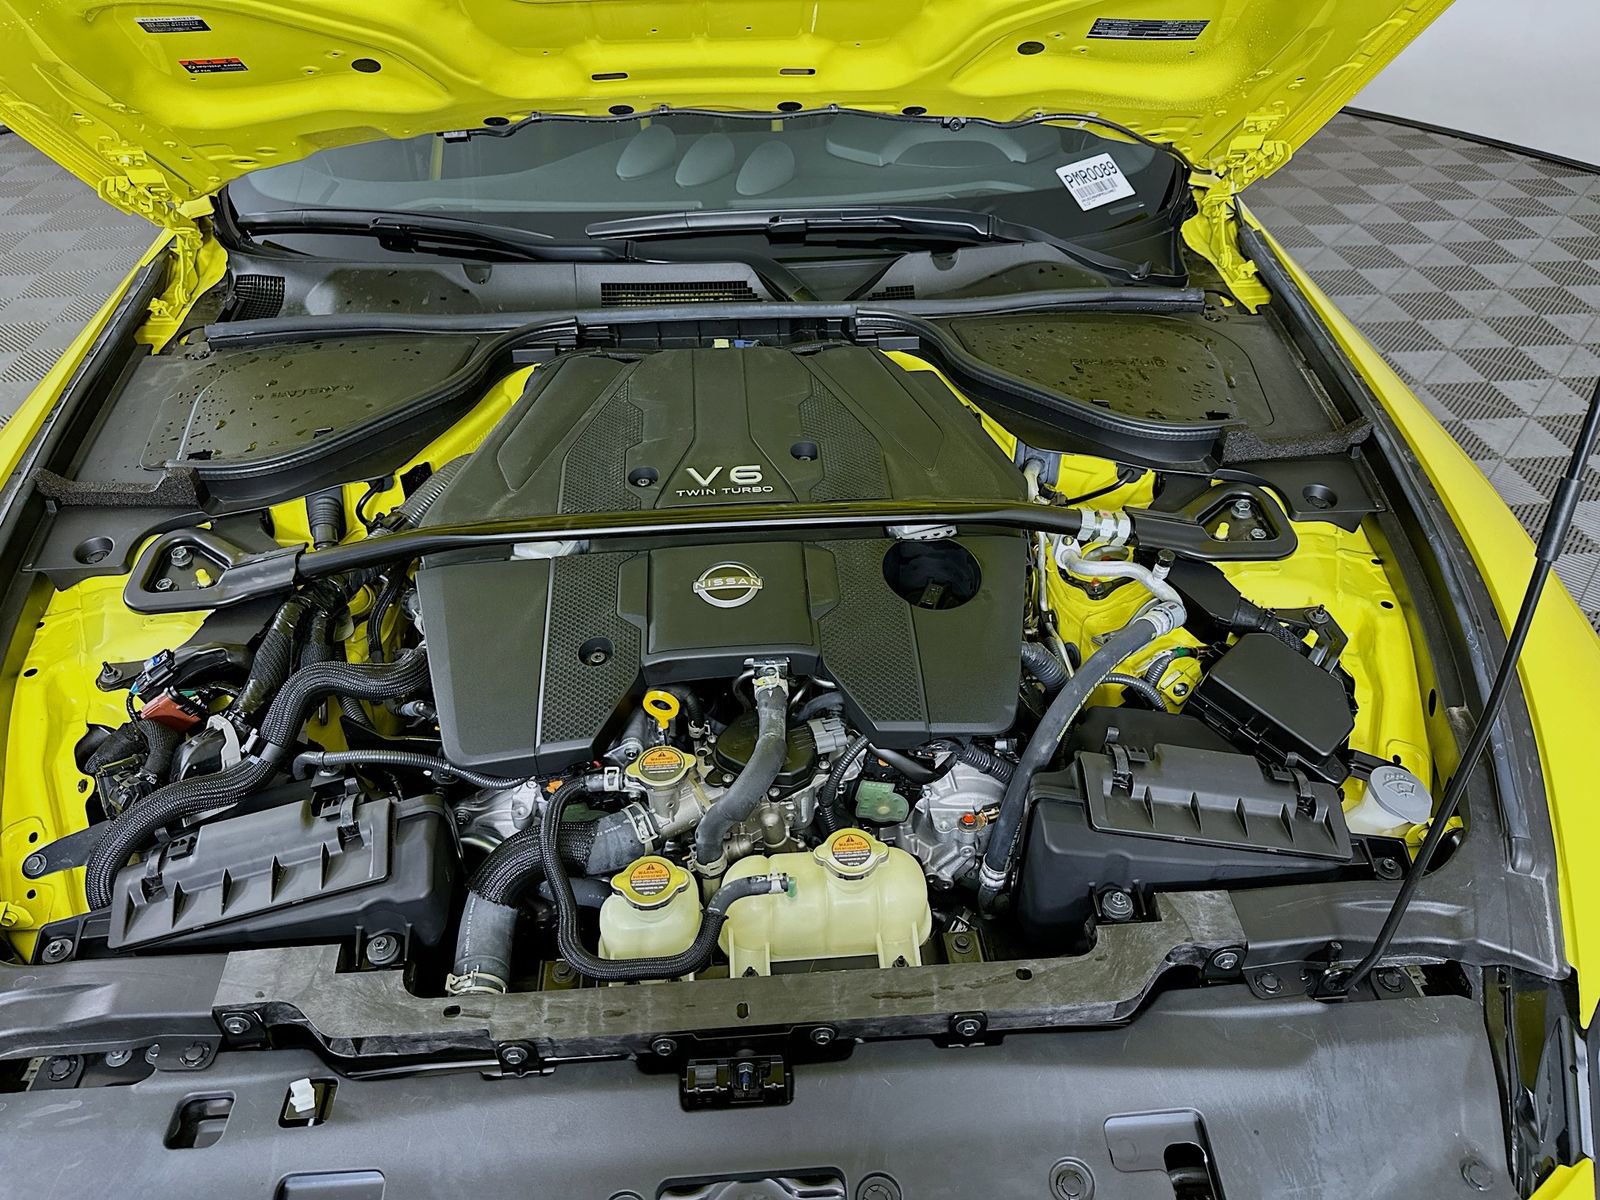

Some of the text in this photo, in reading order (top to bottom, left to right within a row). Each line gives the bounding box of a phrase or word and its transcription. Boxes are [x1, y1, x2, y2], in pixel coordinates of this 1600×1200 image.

[1063, 160, 1118, 189] PMR0089
[686, 464, 763, 487] V6
[675, 486, 774, 497] TWIN TURBO
[695, 577, 762, 589] NISSAN
